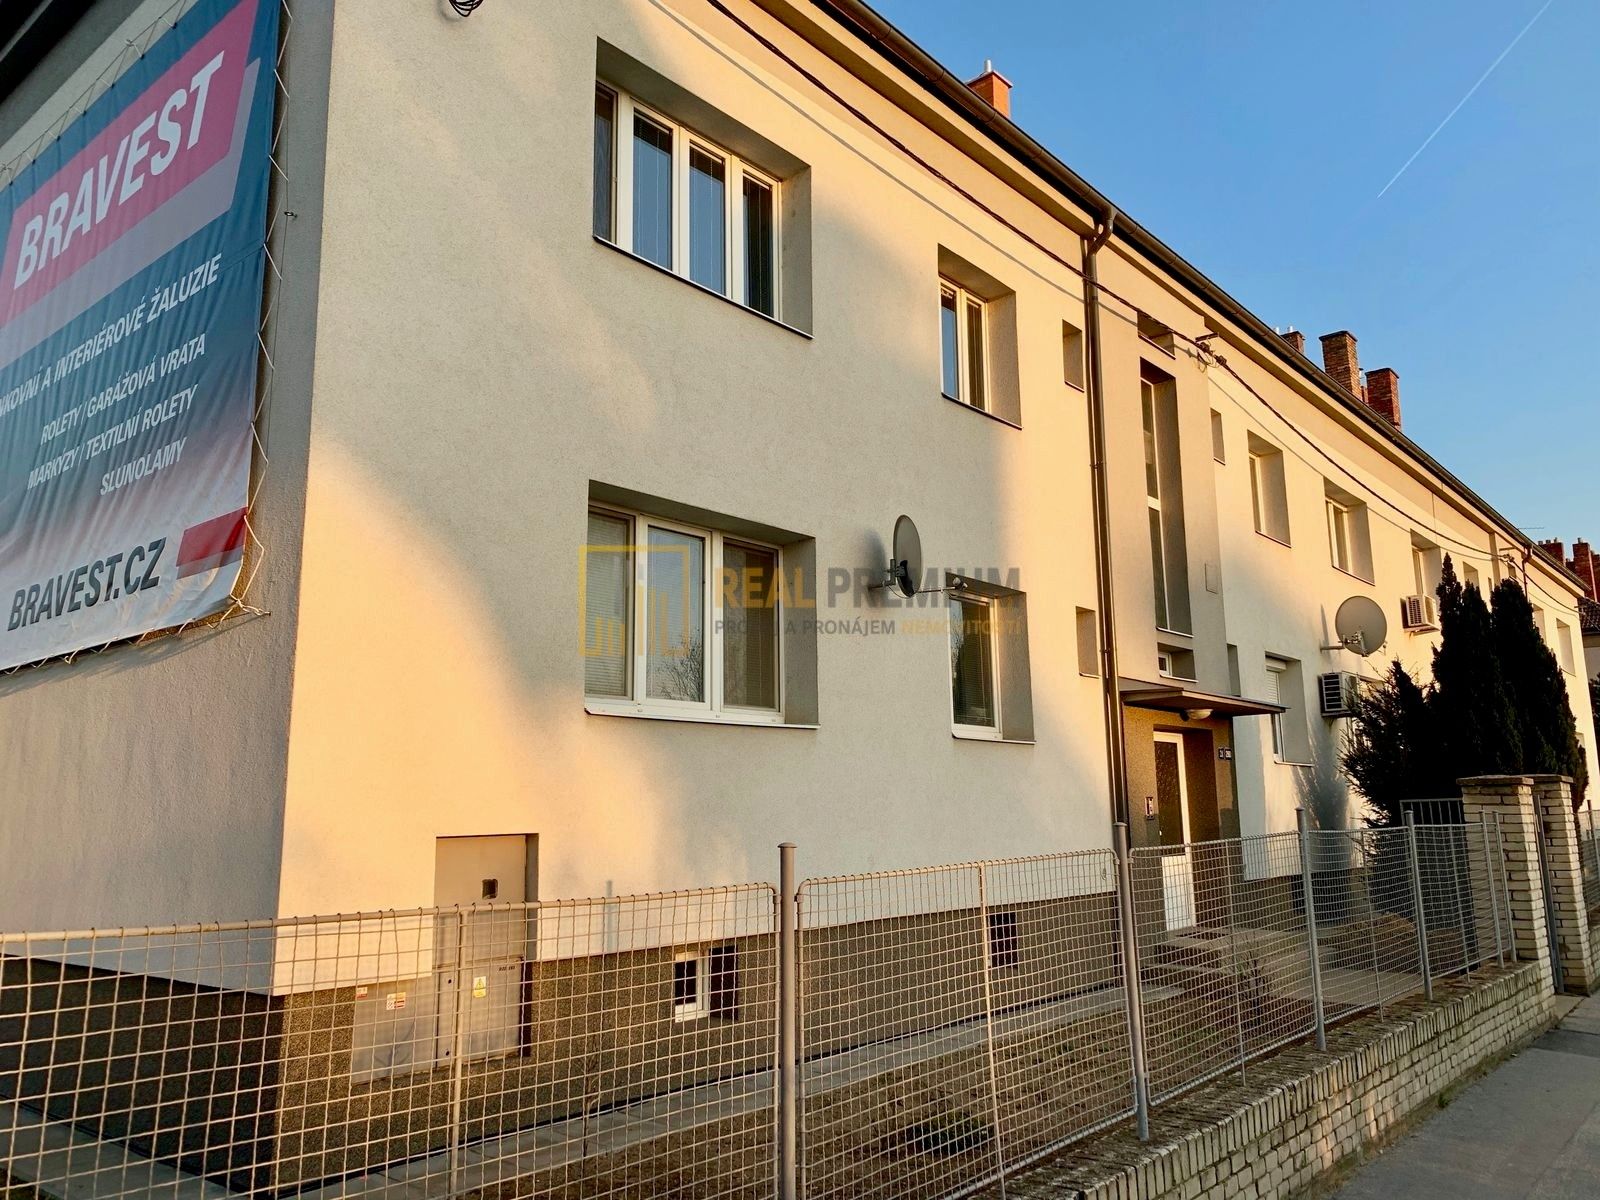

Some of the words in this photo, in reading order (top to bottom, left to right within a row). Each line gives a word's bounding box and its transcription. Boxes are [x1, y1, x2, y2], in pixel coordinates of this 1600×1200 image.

[14, 50, 225, 290] BRAVEST
[41, 366, 52, 391] A
[54, 296, 146, 384] INTERIÉROVÉ
[147, 253, 222, 324] ŽALUZIE
[40, 403, 83, 446] ROLETY
[87, 354, 156, 418] GARÁŽOVÁ
[160, 333, 206, 378] VRATA
[86, 406, 143, 460] TEXTILNÍ
[141, 384, 198, 433] ROLETY
[100, 436, 187, 495] SLUNOLAMY
[7, 537, 167, 631] BRAVEST.CZ
